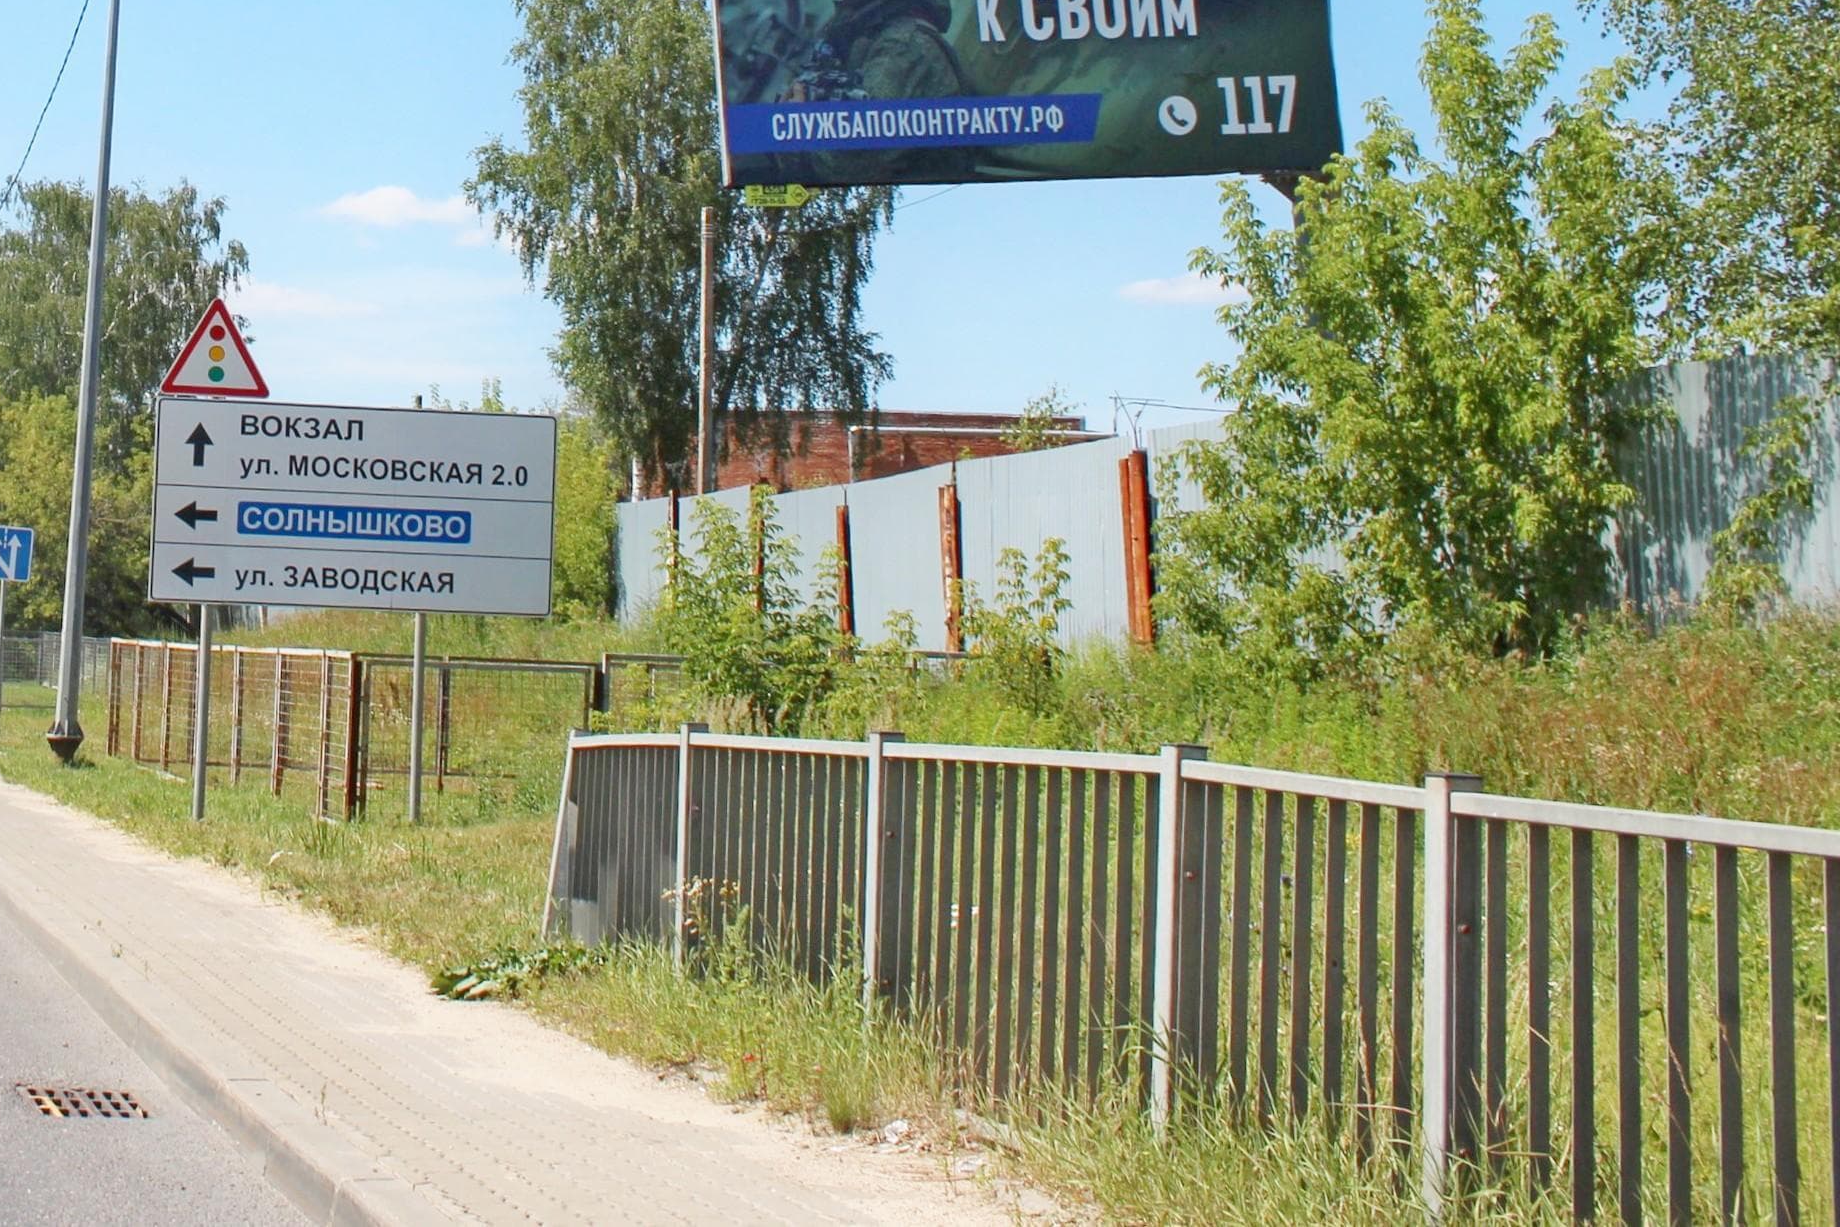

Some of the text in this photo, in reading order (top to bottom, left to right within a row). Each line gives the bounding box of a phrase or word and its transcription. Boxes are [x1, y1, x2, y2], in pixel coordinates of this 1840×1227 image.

[771, 101, 1065, 141] СЛУЖБАПОКОНТРАКТУ.РФ
[1217, 74, 1297, 135] 117
[239, 414, 364, 441] ВОКЗАЛ
[239, 454, 529, 487] ул. МОСКОВСКАЯ 2.0
[242, 506, 467, 540] СОЛНЫШКОВО
[234, 565, 455, 596] ул. ЗАВОДСКАЯ
